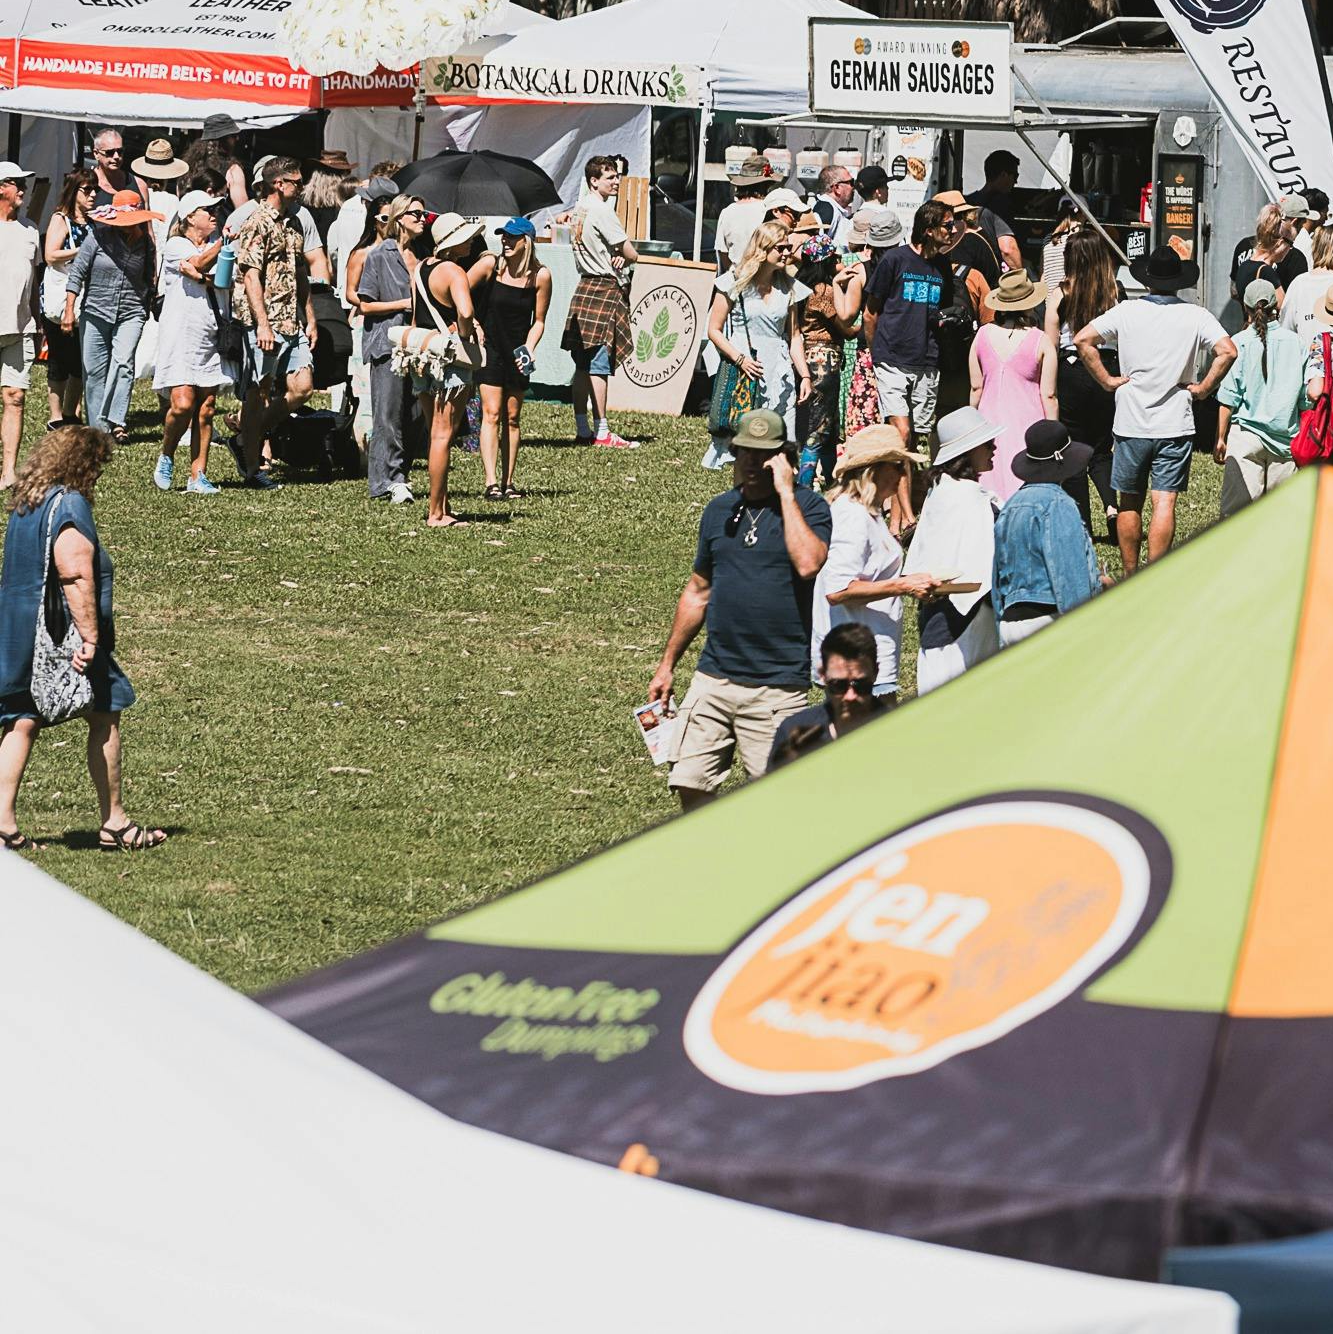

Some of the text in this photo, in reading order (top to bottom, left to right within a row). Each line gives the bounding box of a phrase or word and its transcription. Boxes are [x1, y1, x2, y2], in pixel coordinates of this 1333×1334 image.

[877, 41, 947, 55] AWARD WINNING
[23, 56, 103, 75] HANDMADE
[106, 60, 168, 79] LEATHER
[171, 65, 212, 82] BELTS
[222, 71, 265, 87] MADE
[267, 72, 287, 88] TO
[289, 74, 311, 90] FIT
[451, 63, 671, 98] BOTANICAL DRINKS
[830, 59, 995, 95] GERMAN SAUSAGES
[1221, 36, 1309, 197] RESTAUR
[1165, 186, 1175, 196] THE
[624, 358, 683, 383] RADITIONAL
[771, 850, 990, 958] jen
[748, 937, 940, 1016] jiao
